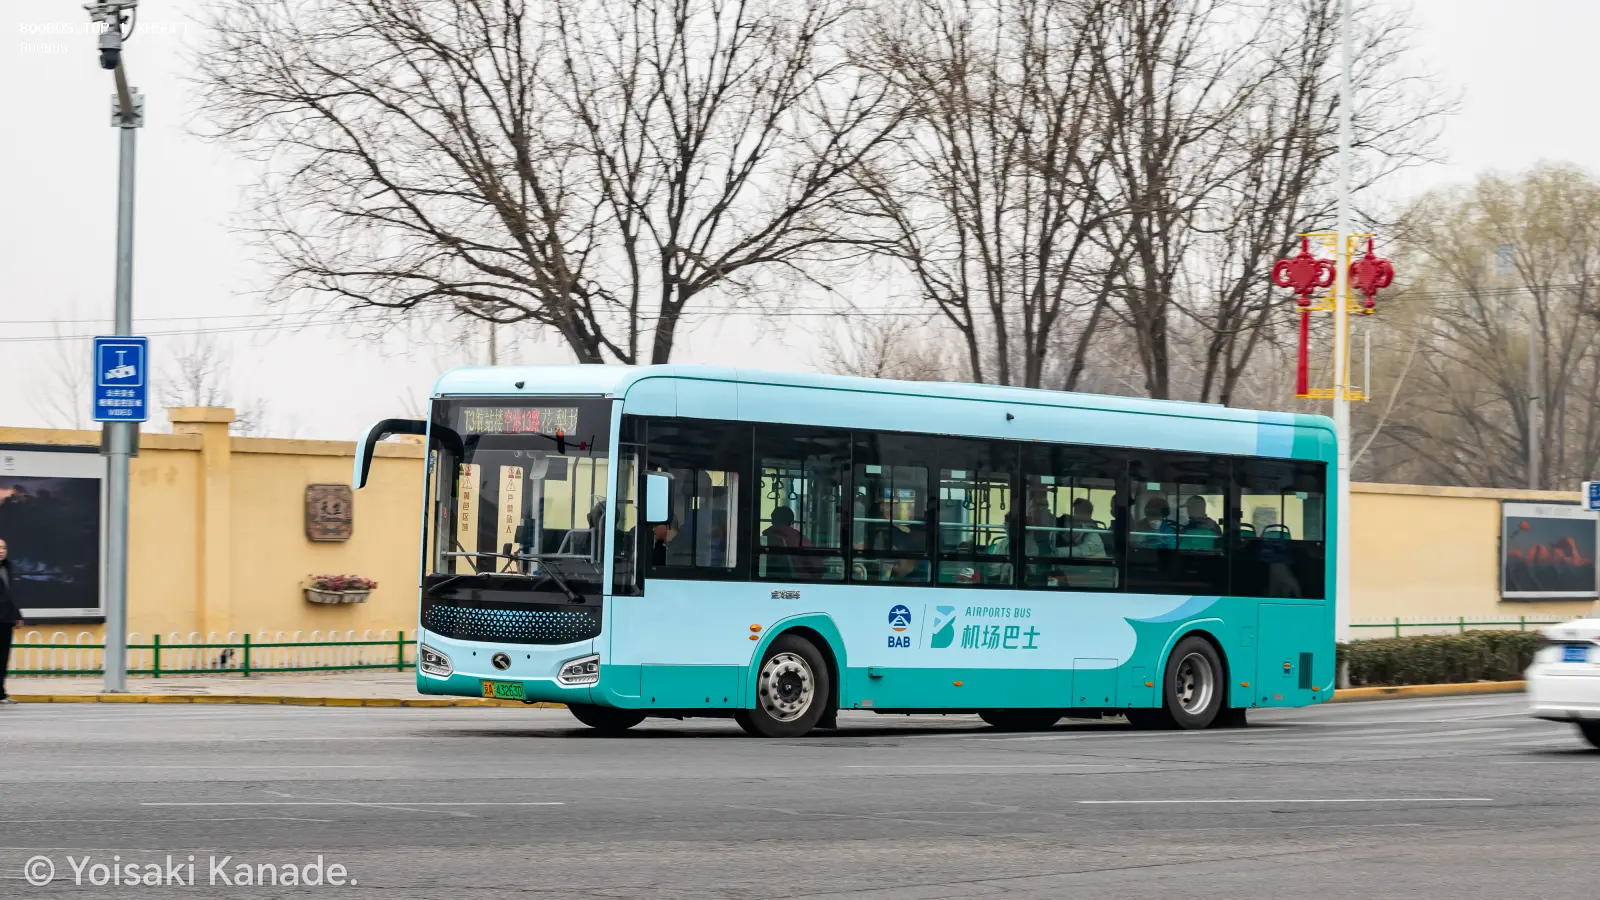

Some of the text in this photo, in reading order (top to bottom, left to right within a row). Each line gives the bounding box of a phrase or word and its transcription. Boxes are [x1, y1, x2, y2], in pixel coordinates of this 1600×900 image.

[965, 606, 1032, 618] AIRPORTS BUS
[887, 635, 911, 648] BAB
[960, 624, 1041, 650] 机场巴士
